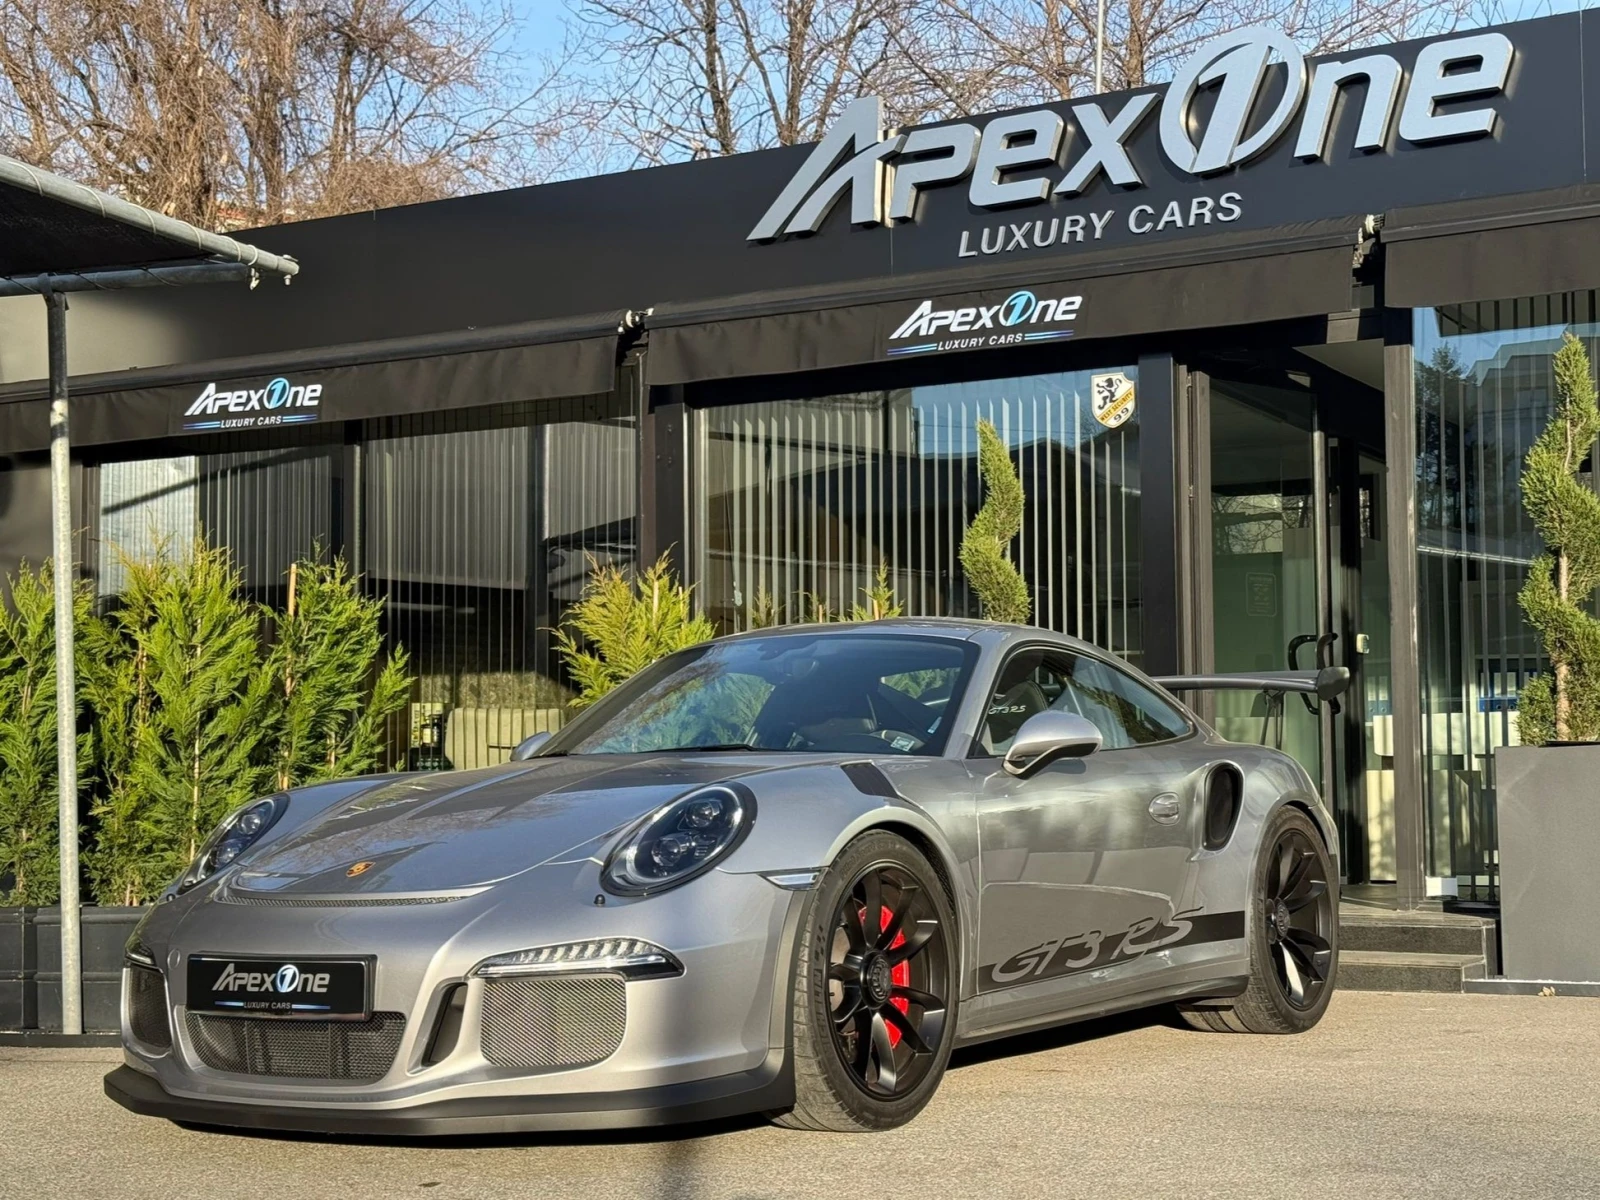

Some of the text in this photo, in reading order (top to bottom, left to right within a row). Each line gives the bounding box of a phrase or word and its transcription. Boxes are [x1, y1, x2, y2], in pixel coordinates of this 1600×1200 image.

[958, 191, 1244, 258] LUXURY CARS
[937, 333, 1023, 351] LUXURY CARS
[220, 416, 282, 429] LUXURY CARS
[1114, 407, 1129, 422] 99
[991, 929, 1106, 982] GT3
[1110, 906, 1204, 962] RS
[243, 1001, 291, 1010] LUXURY CARS
